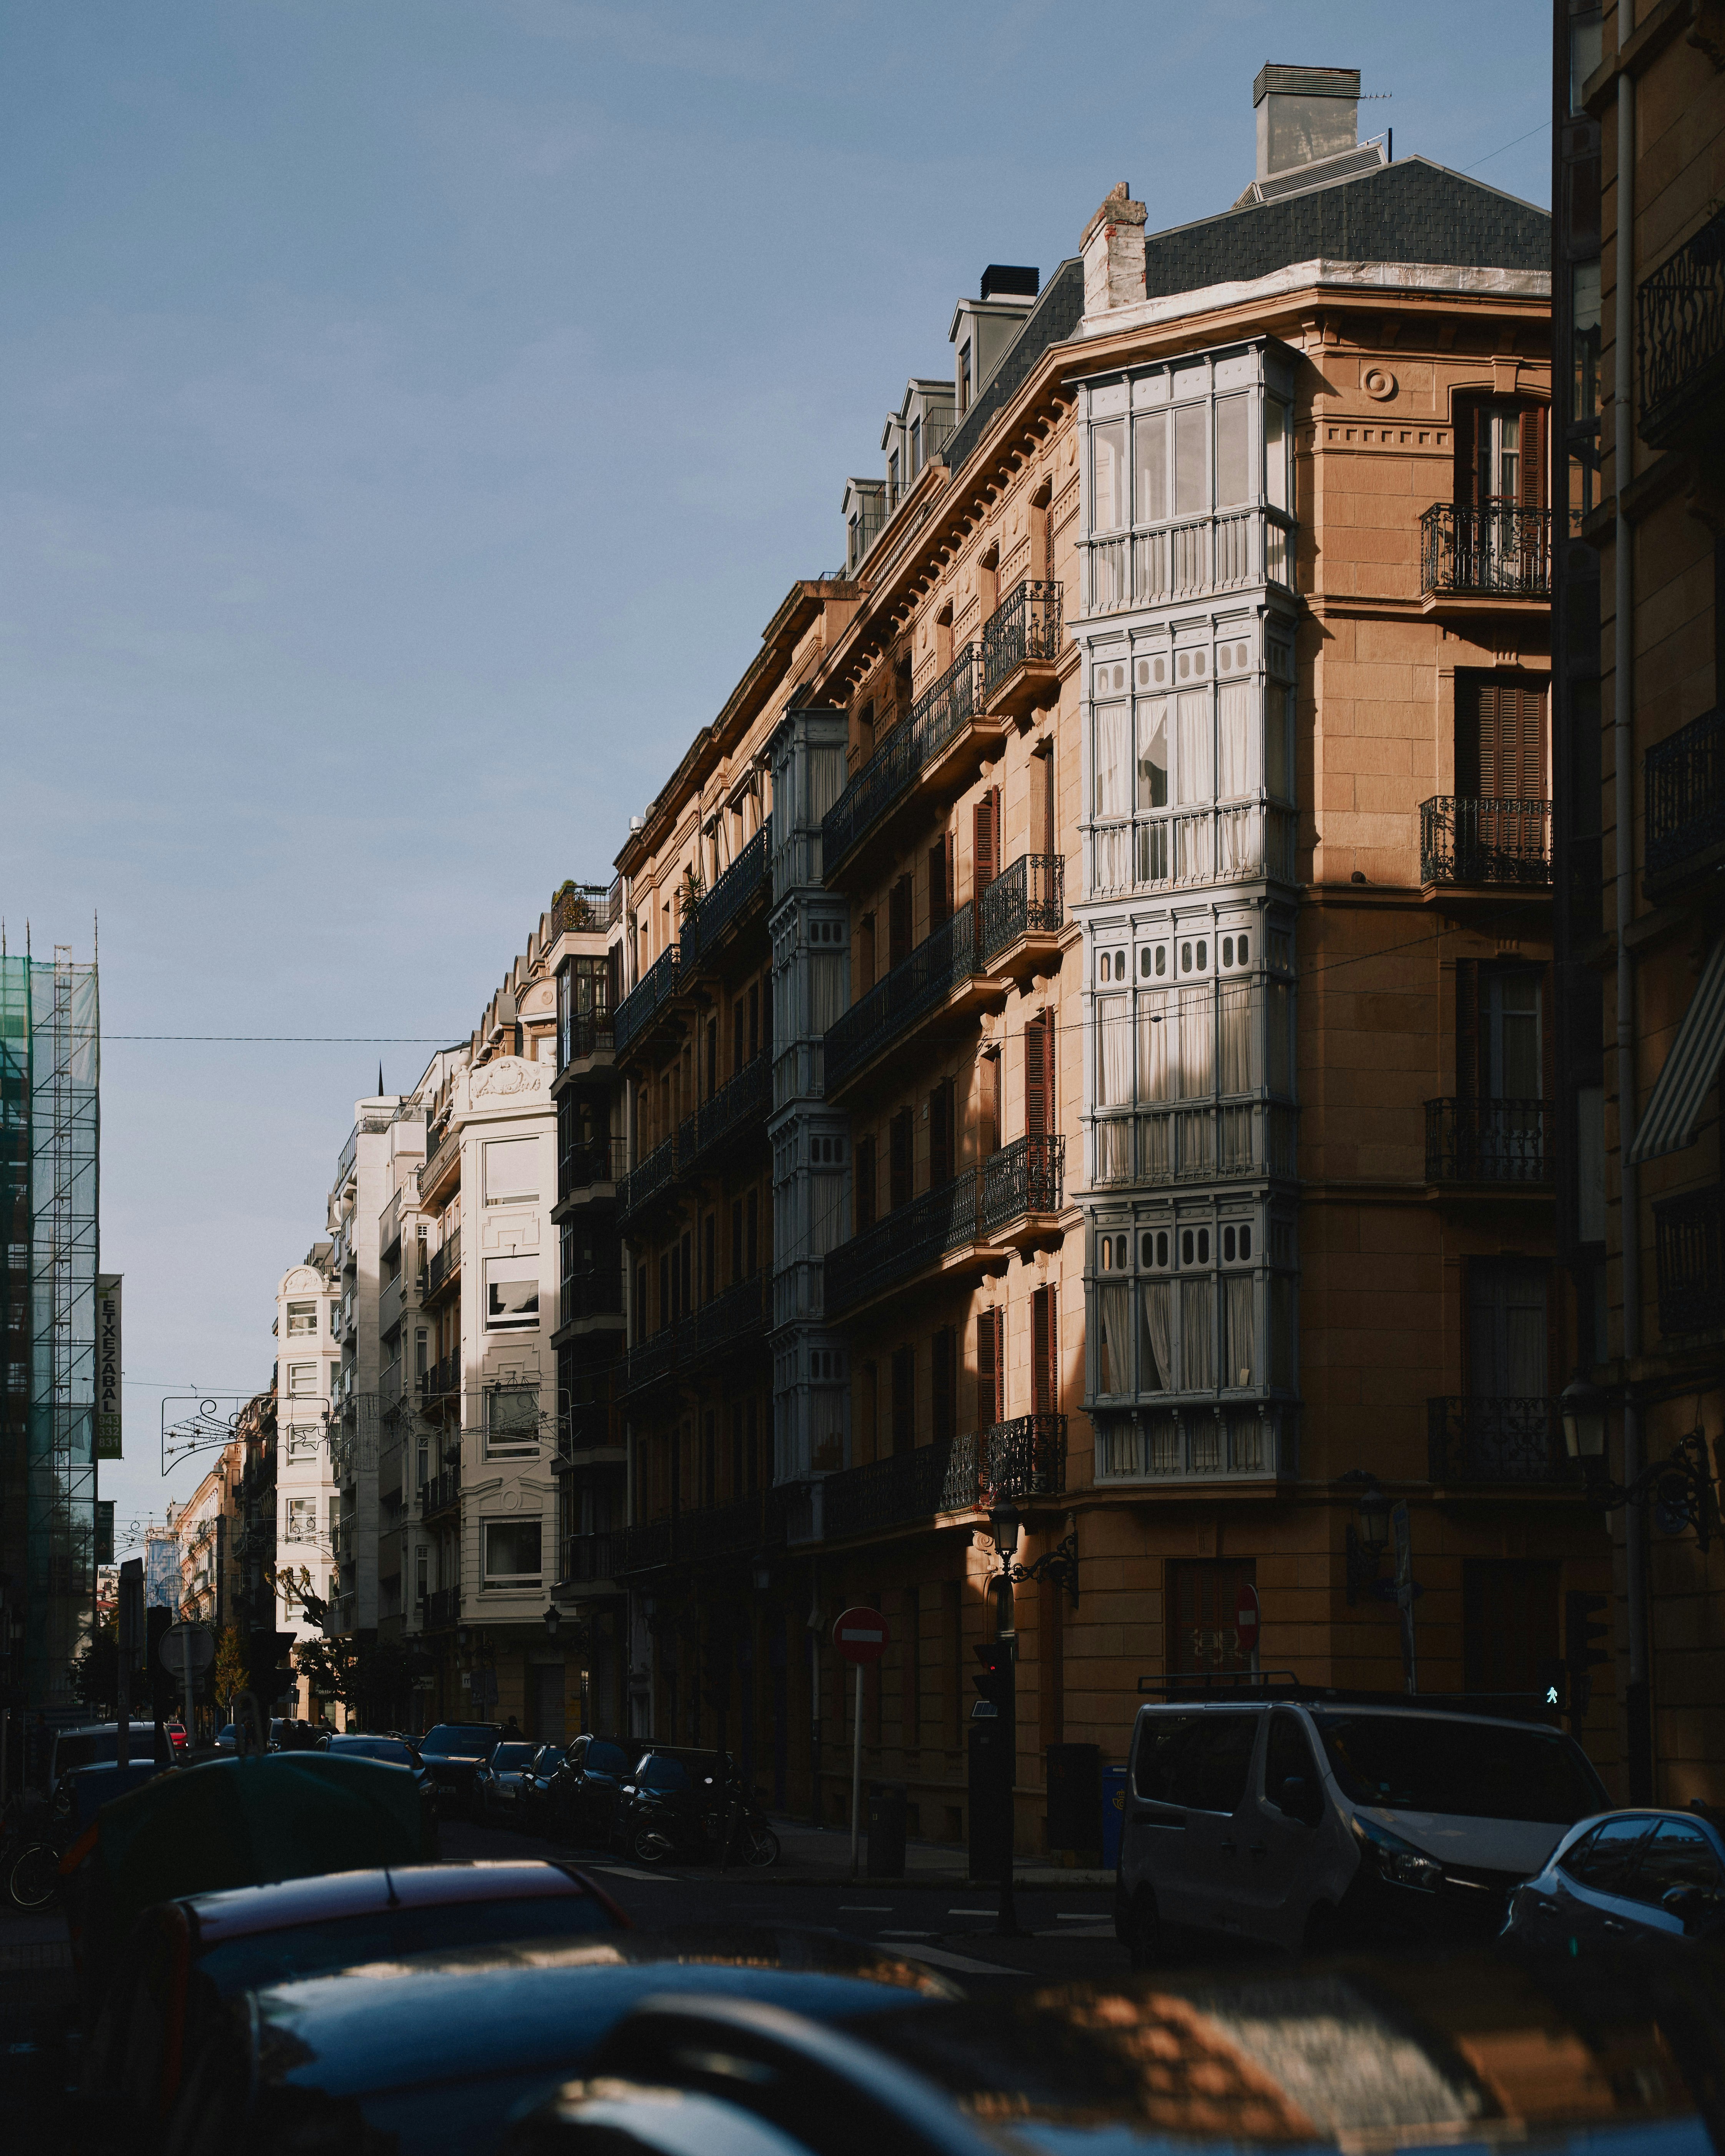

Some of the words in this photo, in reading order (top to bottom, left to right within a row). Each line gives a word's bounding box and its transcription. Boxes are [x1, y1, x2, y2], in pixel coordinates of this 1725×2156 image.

[102, 1300, 116, 1413] ETXEZABAL
[98, 1415, 120, 1425] 943
[98, 1426, 120, 1436] 332
[98, 1437, 118, 1447] 831
